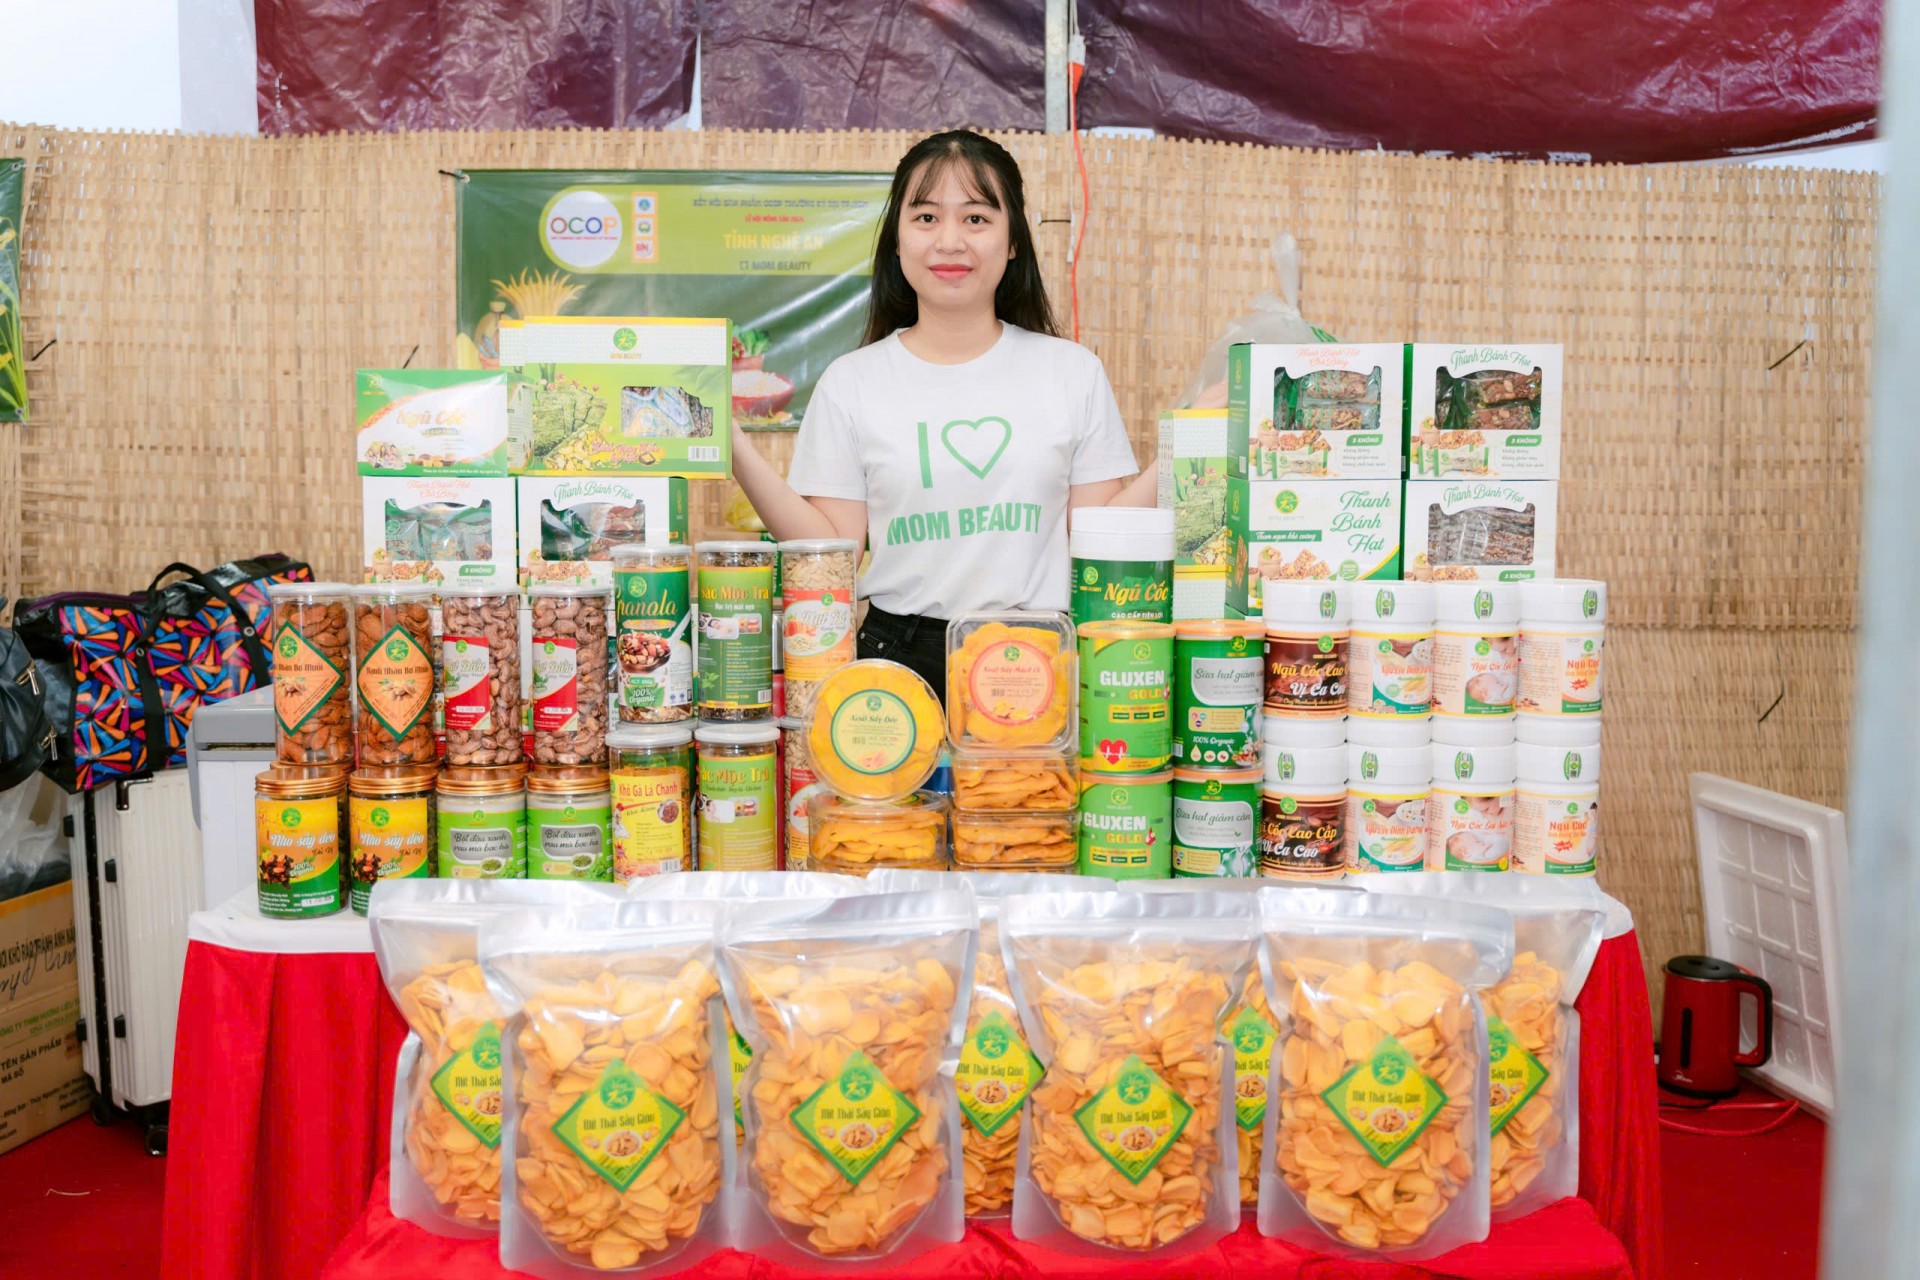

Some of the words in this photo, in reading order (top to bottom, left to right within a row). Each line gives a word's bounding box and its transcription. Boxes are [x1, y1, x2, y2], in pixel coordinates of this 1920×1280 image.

[550, 217, 617, 234] OCOP
[723, 229, 757, 249] TỈNH
[804, 233, 822, 249] AN
[753, 262, 775, 270] MOM
[778, 261, 812, 271] BEAUTY
[1451, 349, 1478, 369] Thanh
[1480, 348, 1509, 362] Bánh
[1510, 352, 1531, 366] Hạt
[397, 411, 432, 428] Ngũ
[918, 422, 933, 489] I
[554, 482, 582, 504] Thanh
[584, 481, 612, 496] Bánh
[613, 485, 634, 500] Hạt
[1443, 485, 1472, 507] Thanh
[1474, 484, 1502, 499] Bánh
[1503, 488, 1524, 503] Hạt
[1340, 490, 1391, 511] Thanh
[887, 511, 951, 545] MOM
[958, 502, 1041, 536] BEAUTY
[1329, 512, 1383, 533] Bánh
[1348, 533, 1385, 555] Hạt
[720, 584, 748, 602] Mộc
[1104, 582, 1140, 605] Ngũ
[1145, 580, 1169, 601] Cốc
[1195, 668, 1215, 679] Sữa
[1217, 668, 1233, 680] hạt
[1235, 670, 1256, 684] giảm
[1272, 662, 1298, 678] Ngũ
[1301, 663, 1322, 678] Cốc
[1326, 665, 1344, 677] Cao
[1100, 670, 1164, 686] GLUXEN
[633, 688, 651, 698] 100%
[1128, 688, 1162, 700] GOLD
[1290, 683, 1307, 698] Vị
[1310, 683, 1328, 696] Ca
[629, 695, 655, 707] Organic
[1193, 735, 1209, 744] 100%
[1210, 736, 1235, 746] Organic
[716, 770, 746, 784] Mộc
[619, 782, 630, 796] Khô
[633, 783, 642, 797] Gà
[645, 783, 654, 797] Lá
[655, 782, 678, 795] Chanh
[1083, 812, 1146, 831] GLUXEN
[1175, 807, 1191, 820] Sữa
[1192, 810, 1207, 822] hạt
[1208, 813, 1235, 825] giảm
[1237, 812, 1251, 820] cân
[454, 832, 468, 842] Bột
[470, 834, 485, 843] đậu
[545, 829, 558, 839] Bột
[560, 830, 576, 839] đậu
[1106, 833, 1143, 844] GOLD
[1267, 822, 1284, 836] Cốc
[1288, 826, 1314, 839] Cao
[1315, 824, 1337, 840] Cấp
[270, 833, 292, 847] Nho
[296, 832, 316, 849] sấy
[319, 831, 336, 845] dẻo
[360, 833, 381, 847] Nho
[384, 832, 403, 849] sấy
[406, 832, 424, 845] dẻo
[469, 844, 482, 852] má
[484, 843, 498, 852] bạc
[575, 840, 589, 849] bạc
[1273, 844, 1290, 856] Ca
[1293, 845, 1319, 858] Cao
[290, 867, 314, 877] Organic
[293, 861, 311, 871] 100%
[378, 867, 402, 877] Organic
[380, 862, 398, 871] 100%
[8, 940, 20, 965] KHÔ
[1, 1056, 18, 1071] TÊN
[20, 1049, 37, 1063] SẢN
[38, 1036, 62, 1054] PHẨM
[973, 1063, 989, 1074] Thái
[991, 1065, 1005, 1077] Sấy
[1249, 1059, 1263, 1071] Sấy
[2, 1072, 12, 1084] MÃ
[14, 1067, 24, 1078] SỐ
[1491, 1067, 1505, 1079] Sấy
[471, 1076, 487, 1086] Thái
[1369, 1091, 1385, 1102] Thái
[1388, 1092, 1402, 1104] Sấy
[837, 1108, 854, 1119] Thái
[856, 1107, 871, 1119] Sấy
[1116, 1112, 1132, 1123] Thái
[1135, 1111, 1149, 1122] Sấy
[600, 1117, 617, 1129] Thái
[620, 1115, 635, 1127] Sấy
